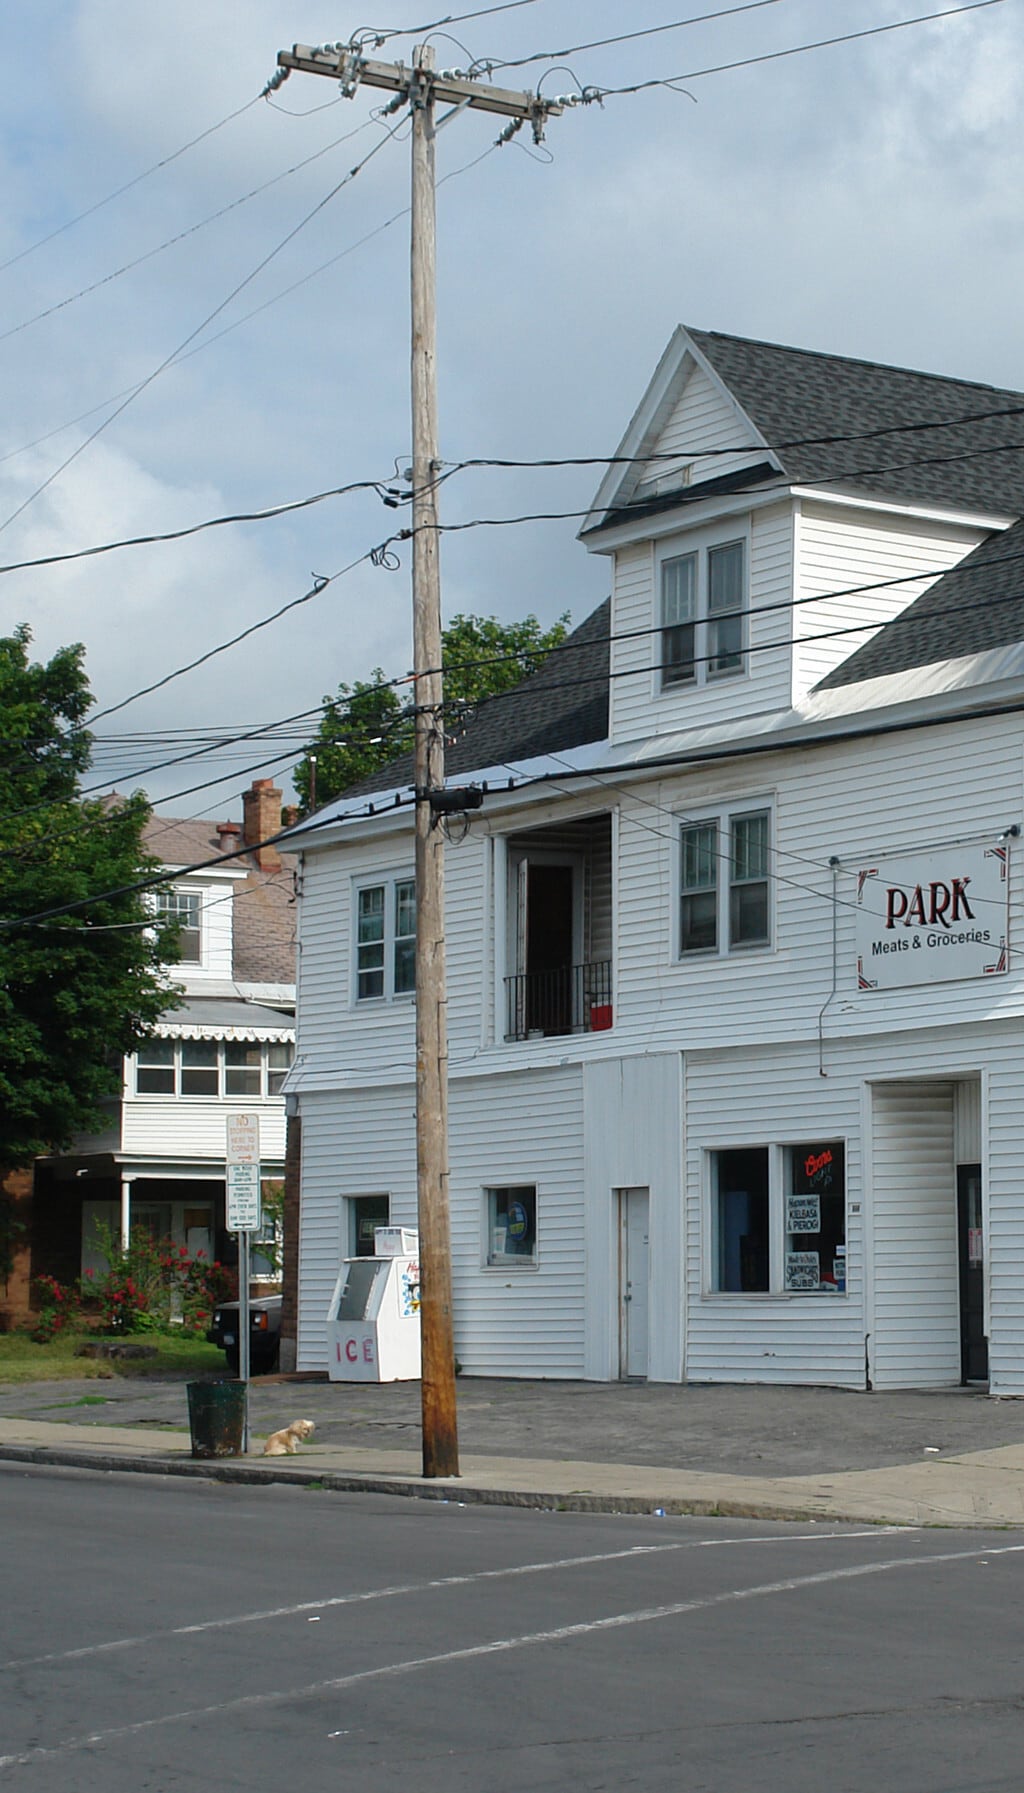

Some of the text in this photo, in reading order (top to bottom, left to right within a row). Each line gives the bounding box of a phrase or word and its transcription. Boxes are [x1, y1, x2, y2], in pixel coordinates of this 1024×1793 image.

[886, 877, 976, 929] PARK
[872, 928, 990, 956] Meats & Groceries
[336, 1339, 374, 1363] ICE
